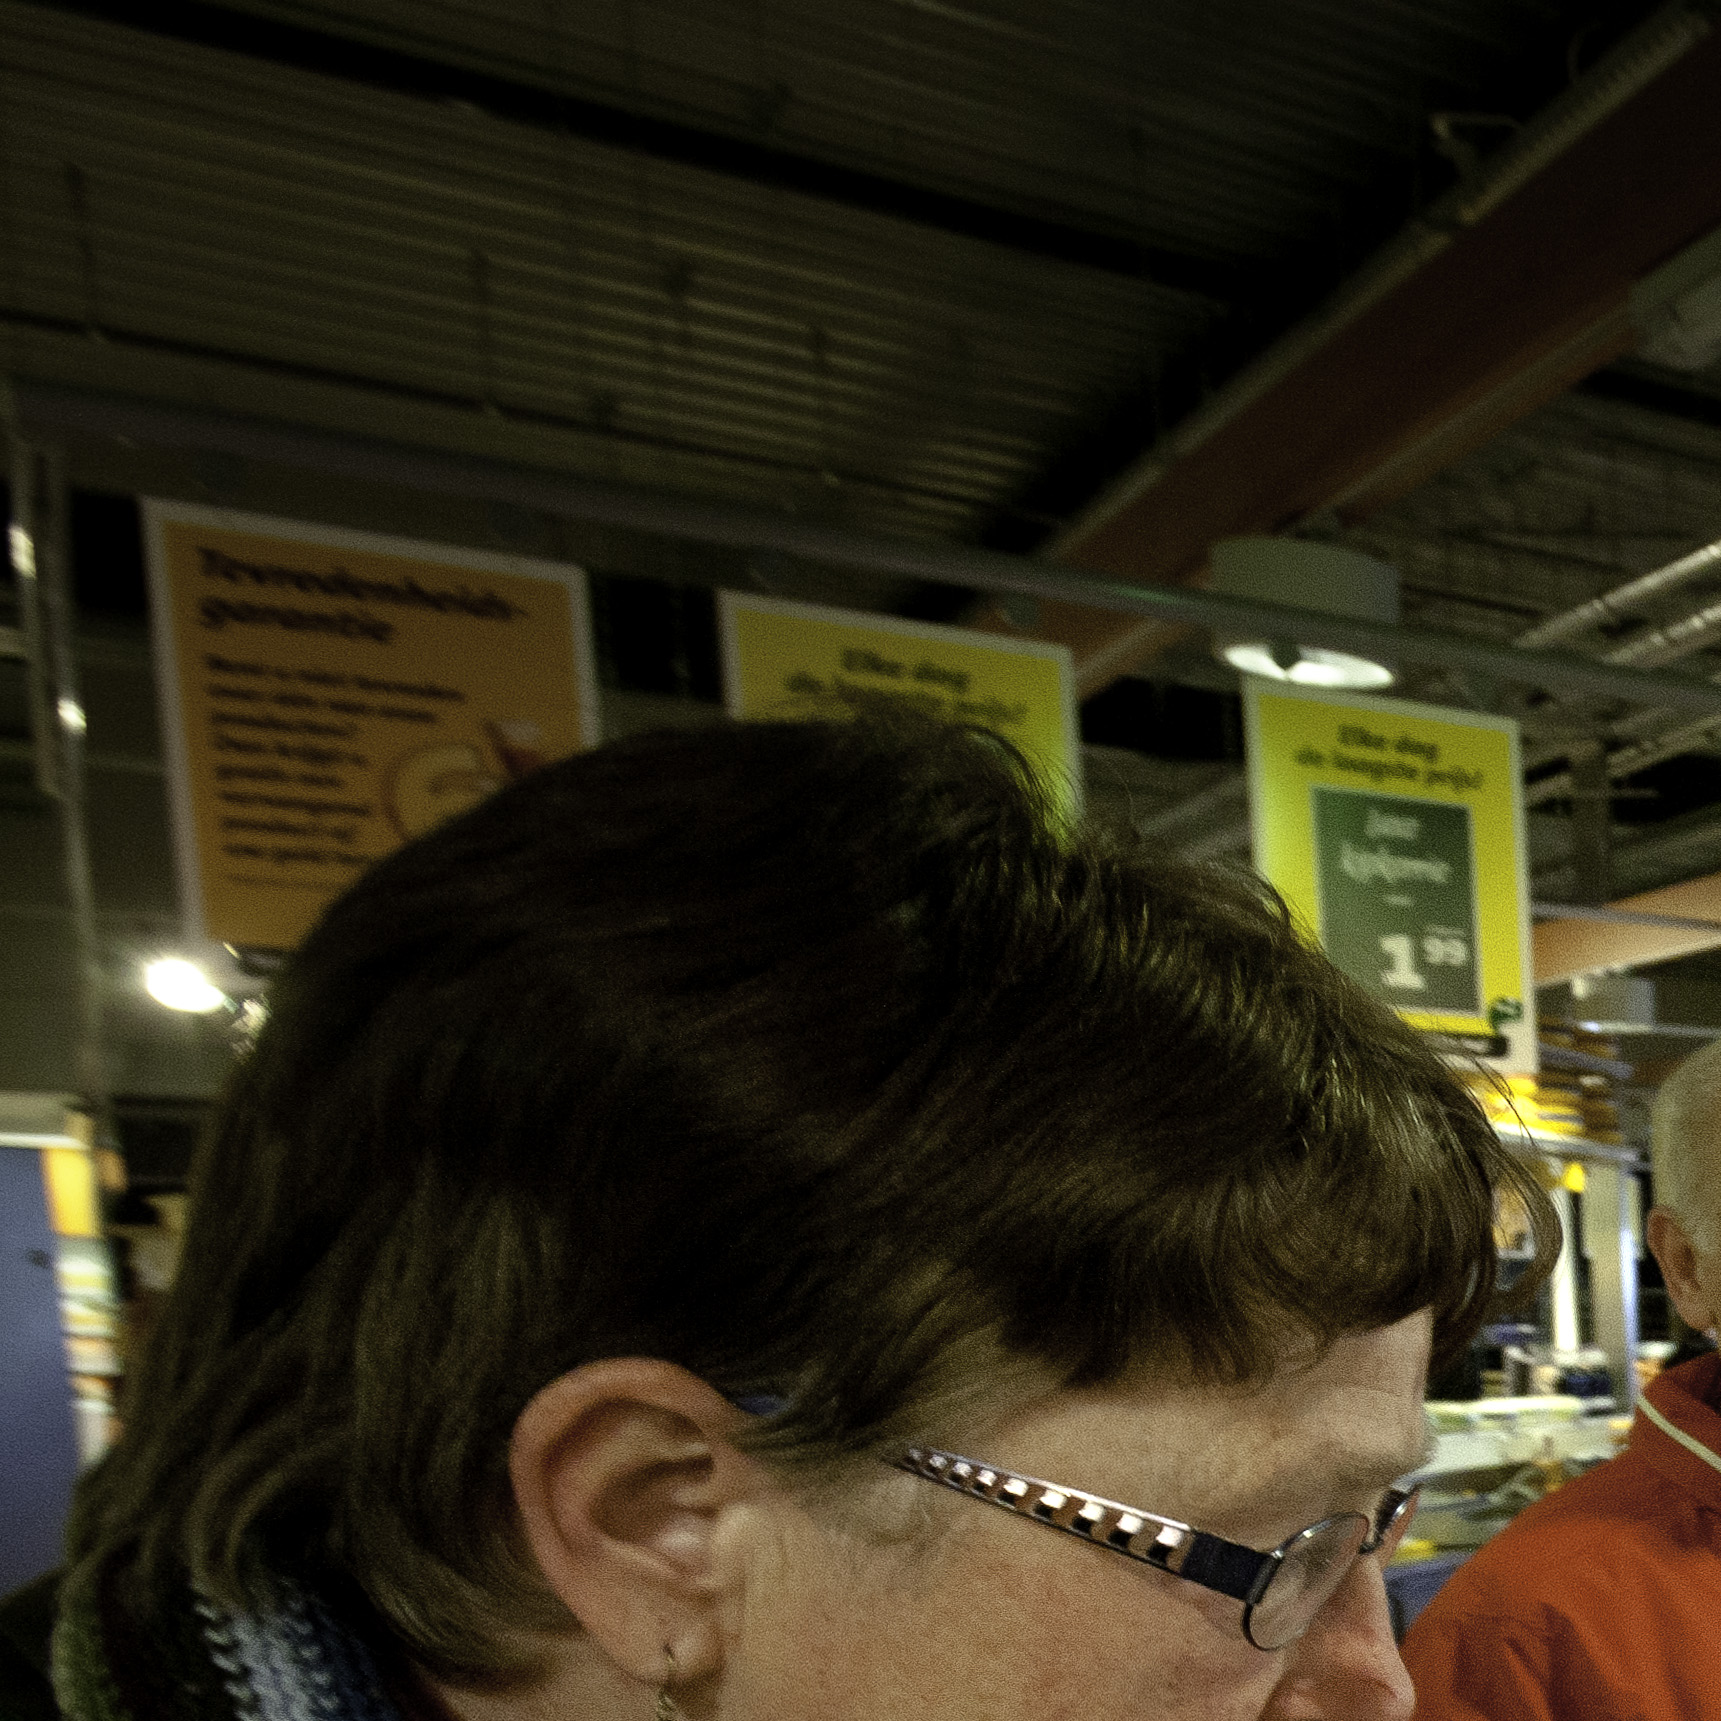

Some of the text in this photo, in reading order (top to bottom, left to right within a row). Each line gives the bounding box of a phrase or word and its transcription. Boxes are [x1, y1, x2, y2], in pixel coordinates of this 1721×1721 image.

[200, 597, 394, 643] garantie
[1294, 745, 1325, 768] de
[1331, 750, 1420, 783] laagste
[1336, 723, 1440, 765] Elke dag
[1379, 933, 1425, 991] 1
